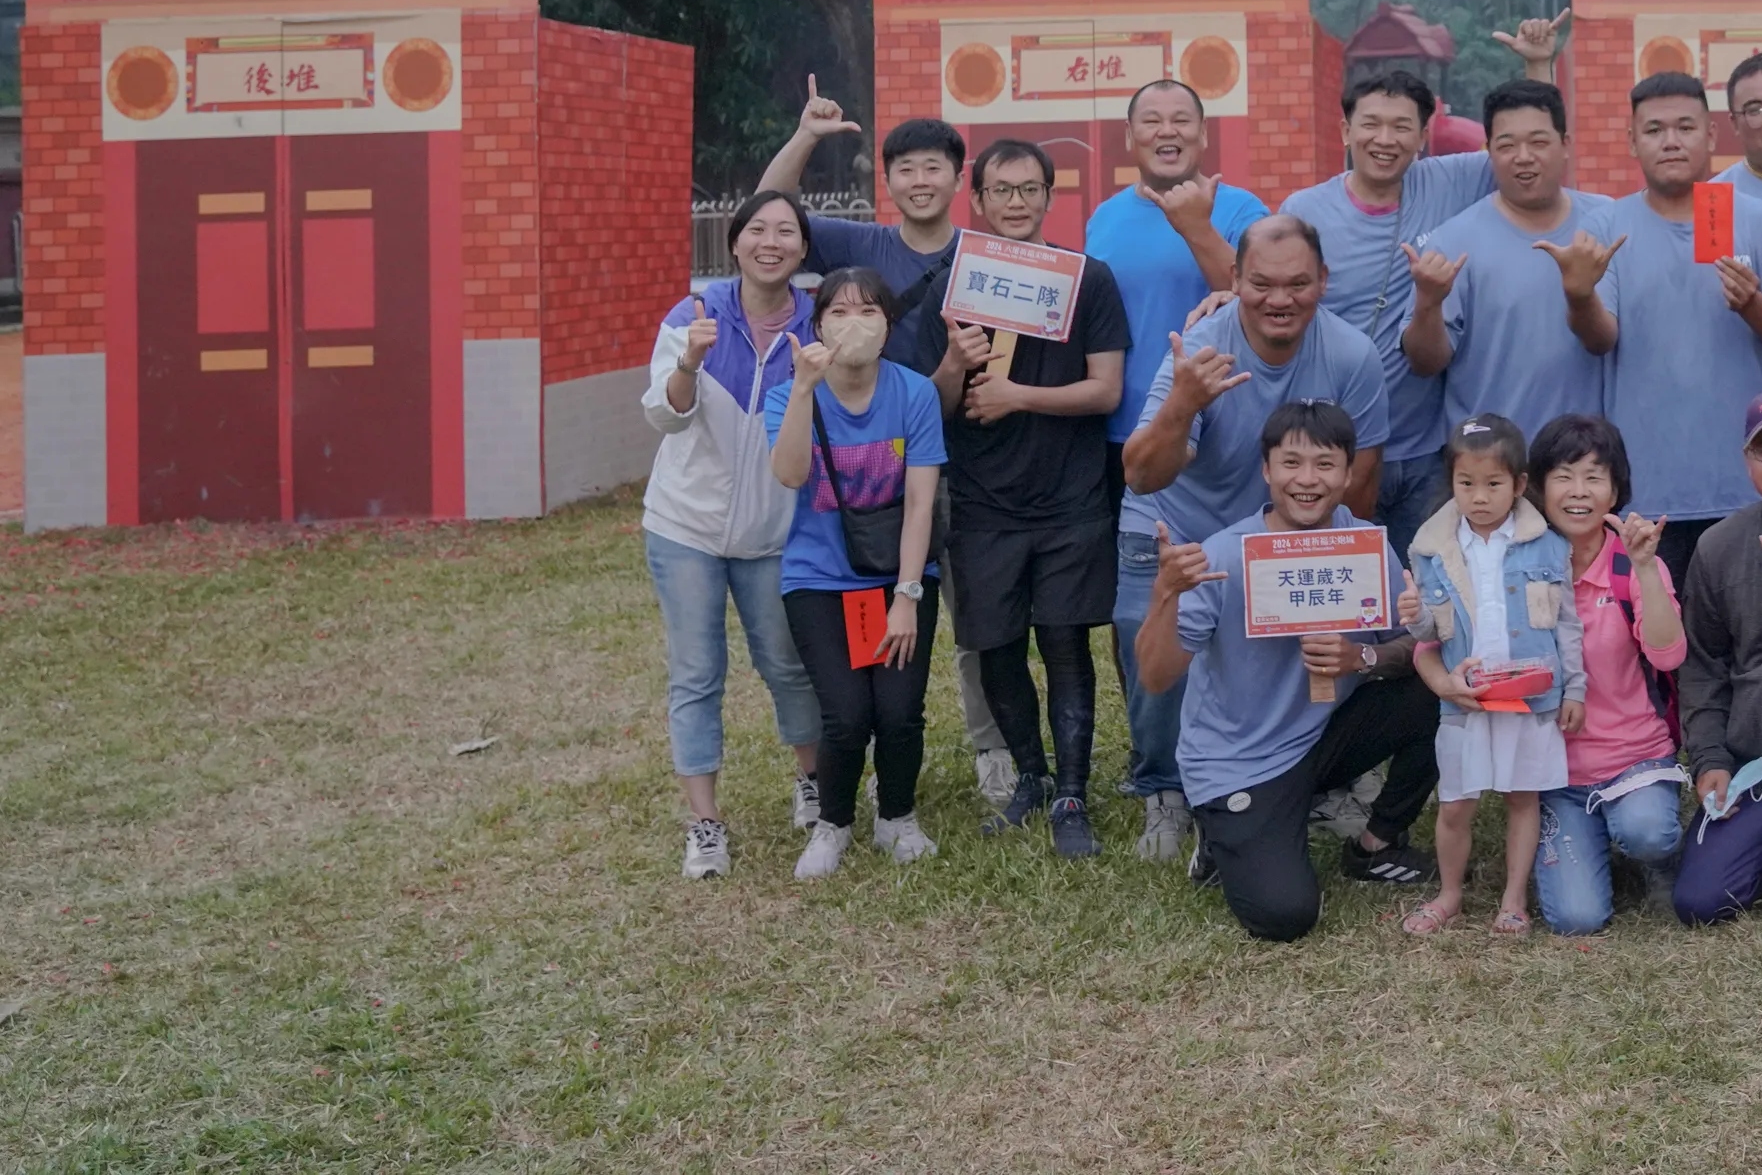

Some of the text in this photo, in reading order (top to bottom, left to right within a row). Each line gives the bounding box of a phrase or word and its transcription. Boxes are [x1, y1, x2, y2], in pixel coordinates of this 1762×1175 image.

[244, 62, 319, 96] 後堆
[966, 270, 1060, 307] 寶石二隊
[1272, 538, 1291, 549] 2024
[1278, 566, 1354, 587] 天運歲次
[1289, 588, 1345, 608] 甲辰年
